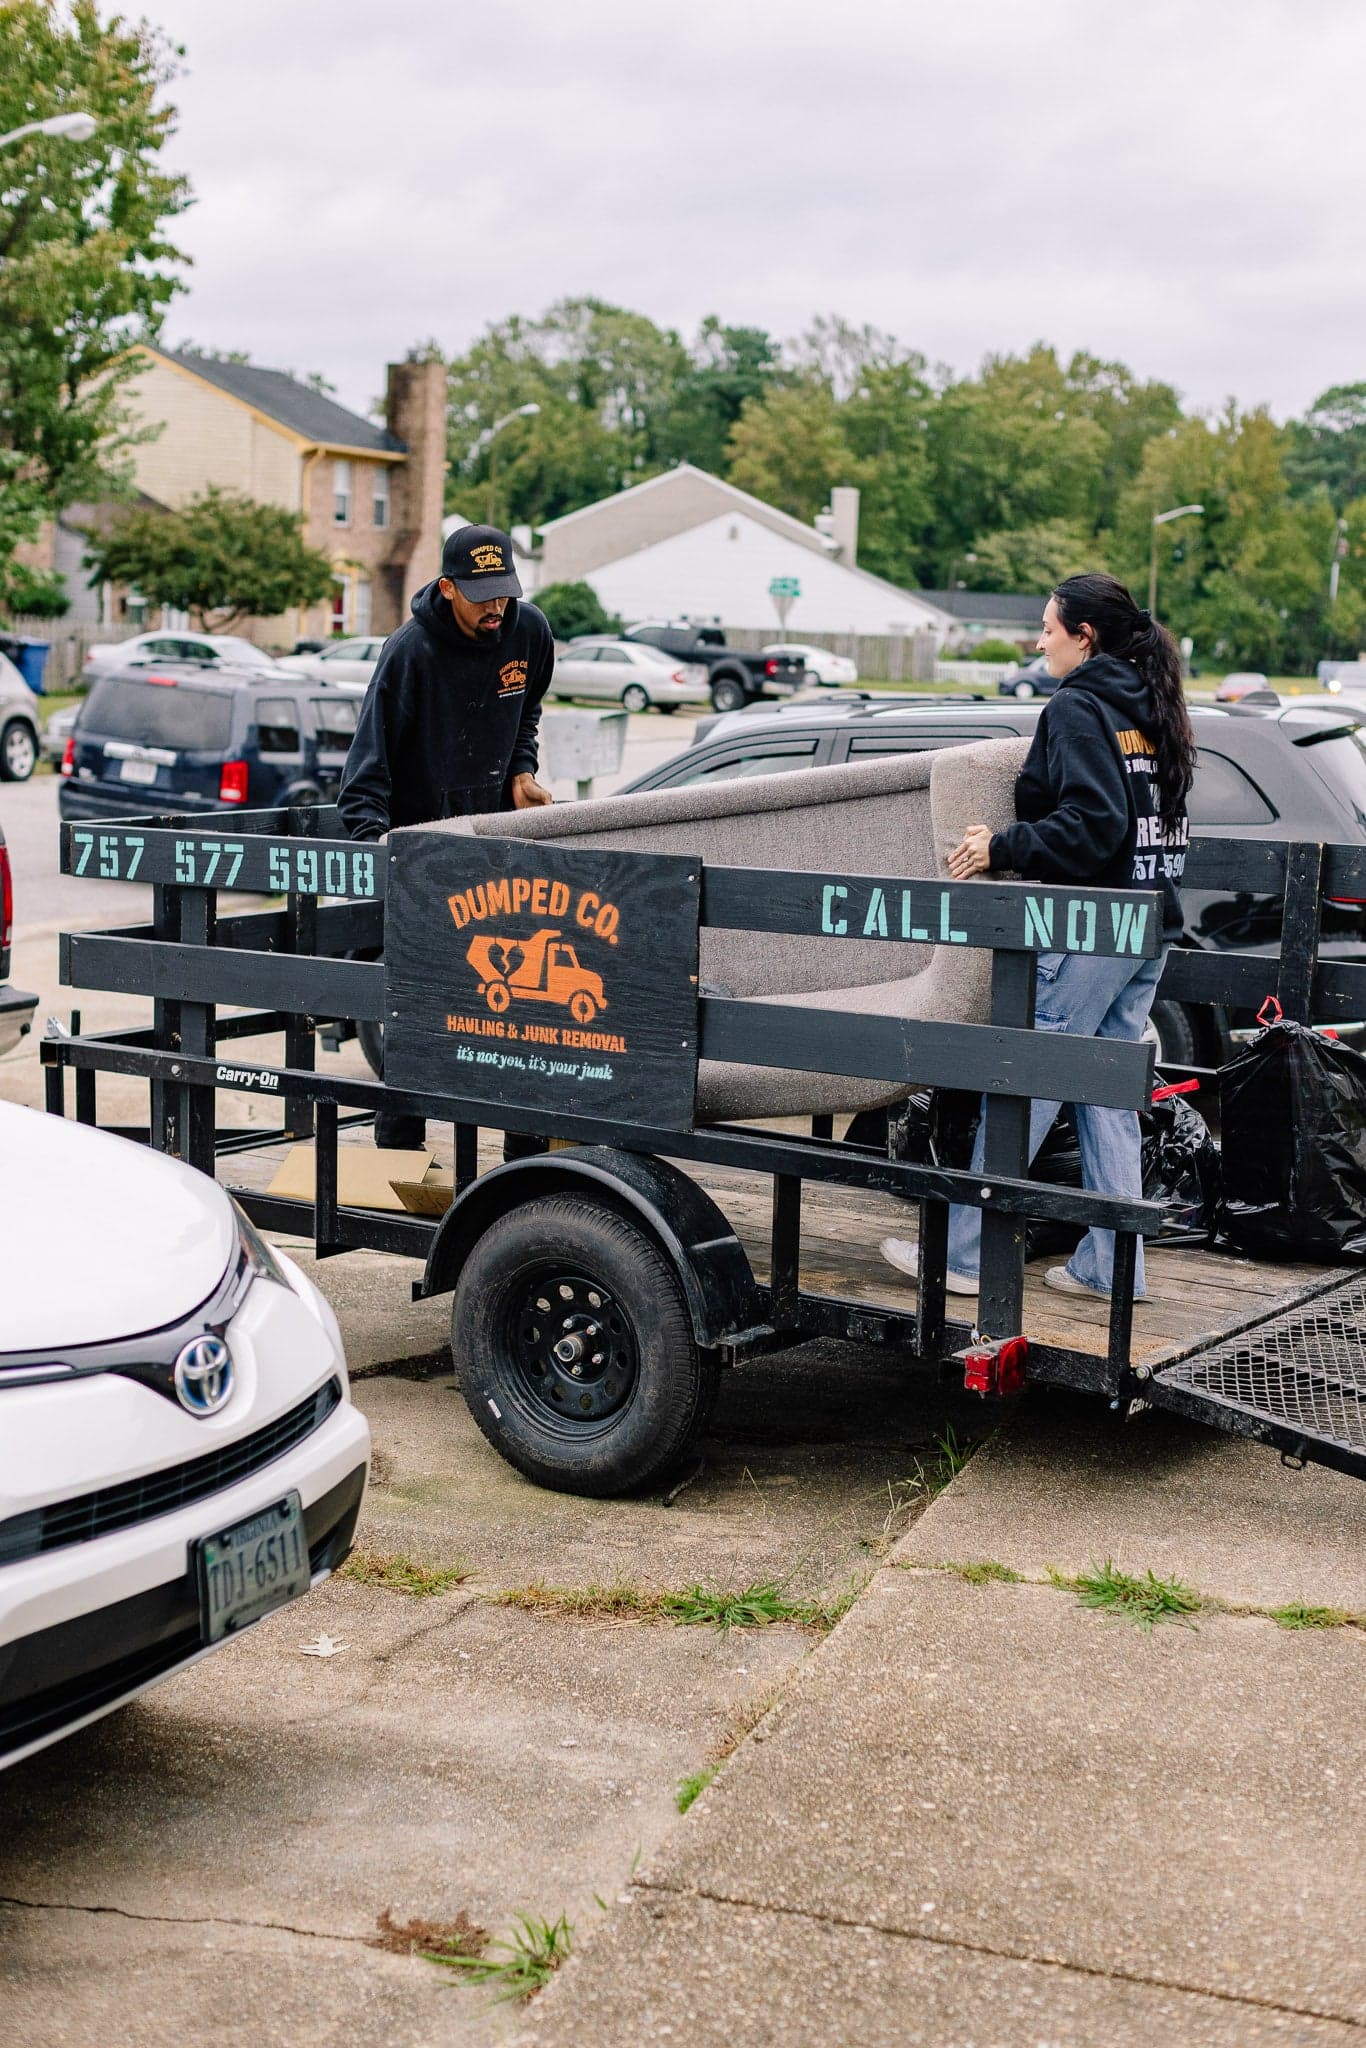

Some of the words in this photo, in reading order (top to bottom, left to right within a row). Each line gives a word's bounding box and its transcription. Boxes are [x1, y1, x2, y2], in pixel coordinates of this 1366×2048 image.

[470, 545, 494, 557] DUMPED
[74, 833, 144, 880] 757
[175, 840, 244, 887] 577
[269, 847, 374, 897] 5908
[448, 878, 570, 930] DUMPED
[576, 892, 620, 945] CO.
[822, 885, 968, 943] CALL
[1025, 896, 1149, 955] NOW
[447, 1015, 505, 1038] HAULING
[507, 1023, 518, 1040] &
[521, 1024, 559, 1046] JUNK
[562, 1028, 627, 1054] REMOVAL
[216, 1066, 279, 1088] Carry-On
[456, 1045, 474, 1062] it's
[476, 1049, 499, 1065] not
[498, 1053, 526, 1070] you,
[528, 1055, 546, 1071] it's
[546, 1060, 580, 1076] your
[578, 1062, 613, 1081] junk
[210, 1525, 301, 1613] TDJ-6511
